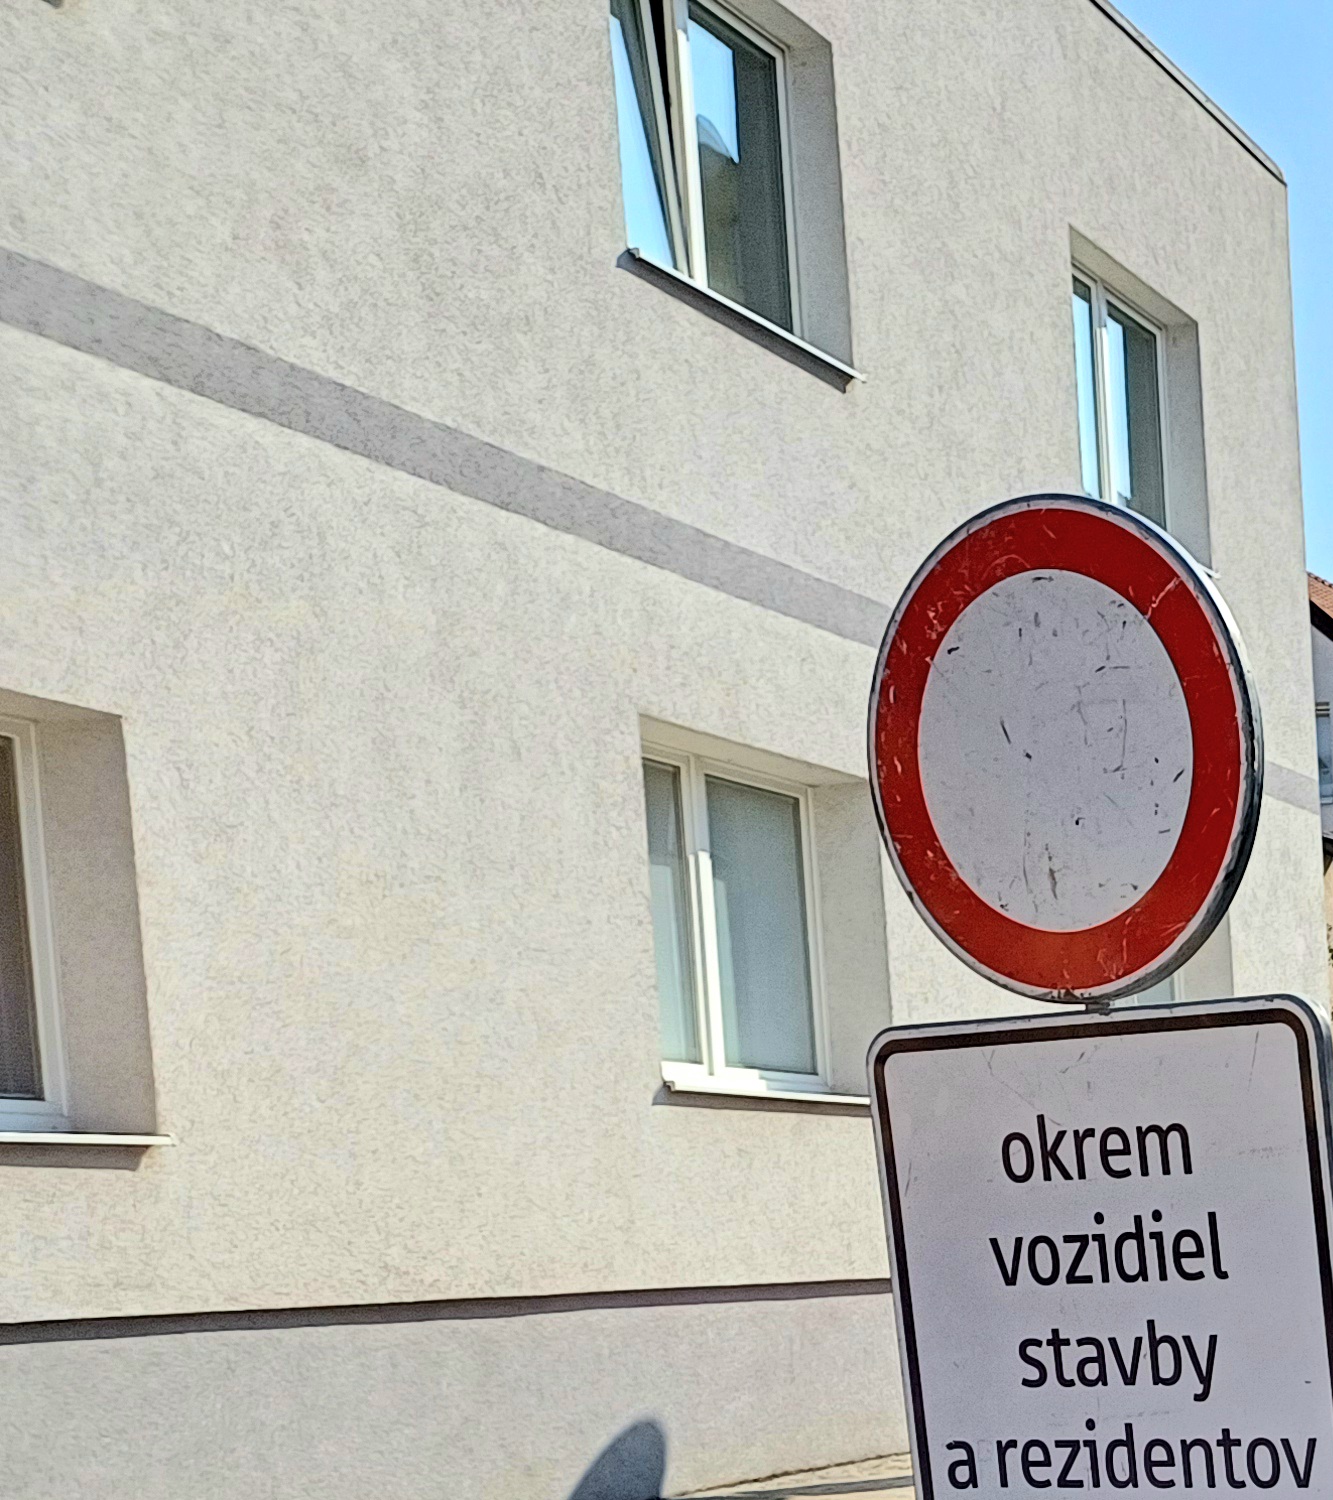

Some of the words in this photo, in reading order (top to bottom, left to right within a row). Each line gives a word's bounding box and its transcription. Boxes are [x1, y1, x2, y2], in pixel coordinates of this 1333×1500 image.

[1000, 1113, 1193, 1184] okrem
[988, 1209, 1230, 1287] vozidiel
[1018, 1319, 1218, 1403] stavby
[945, 1440, 979, 1490] a
[995, 1417, 1318, 1490] rezidentov
